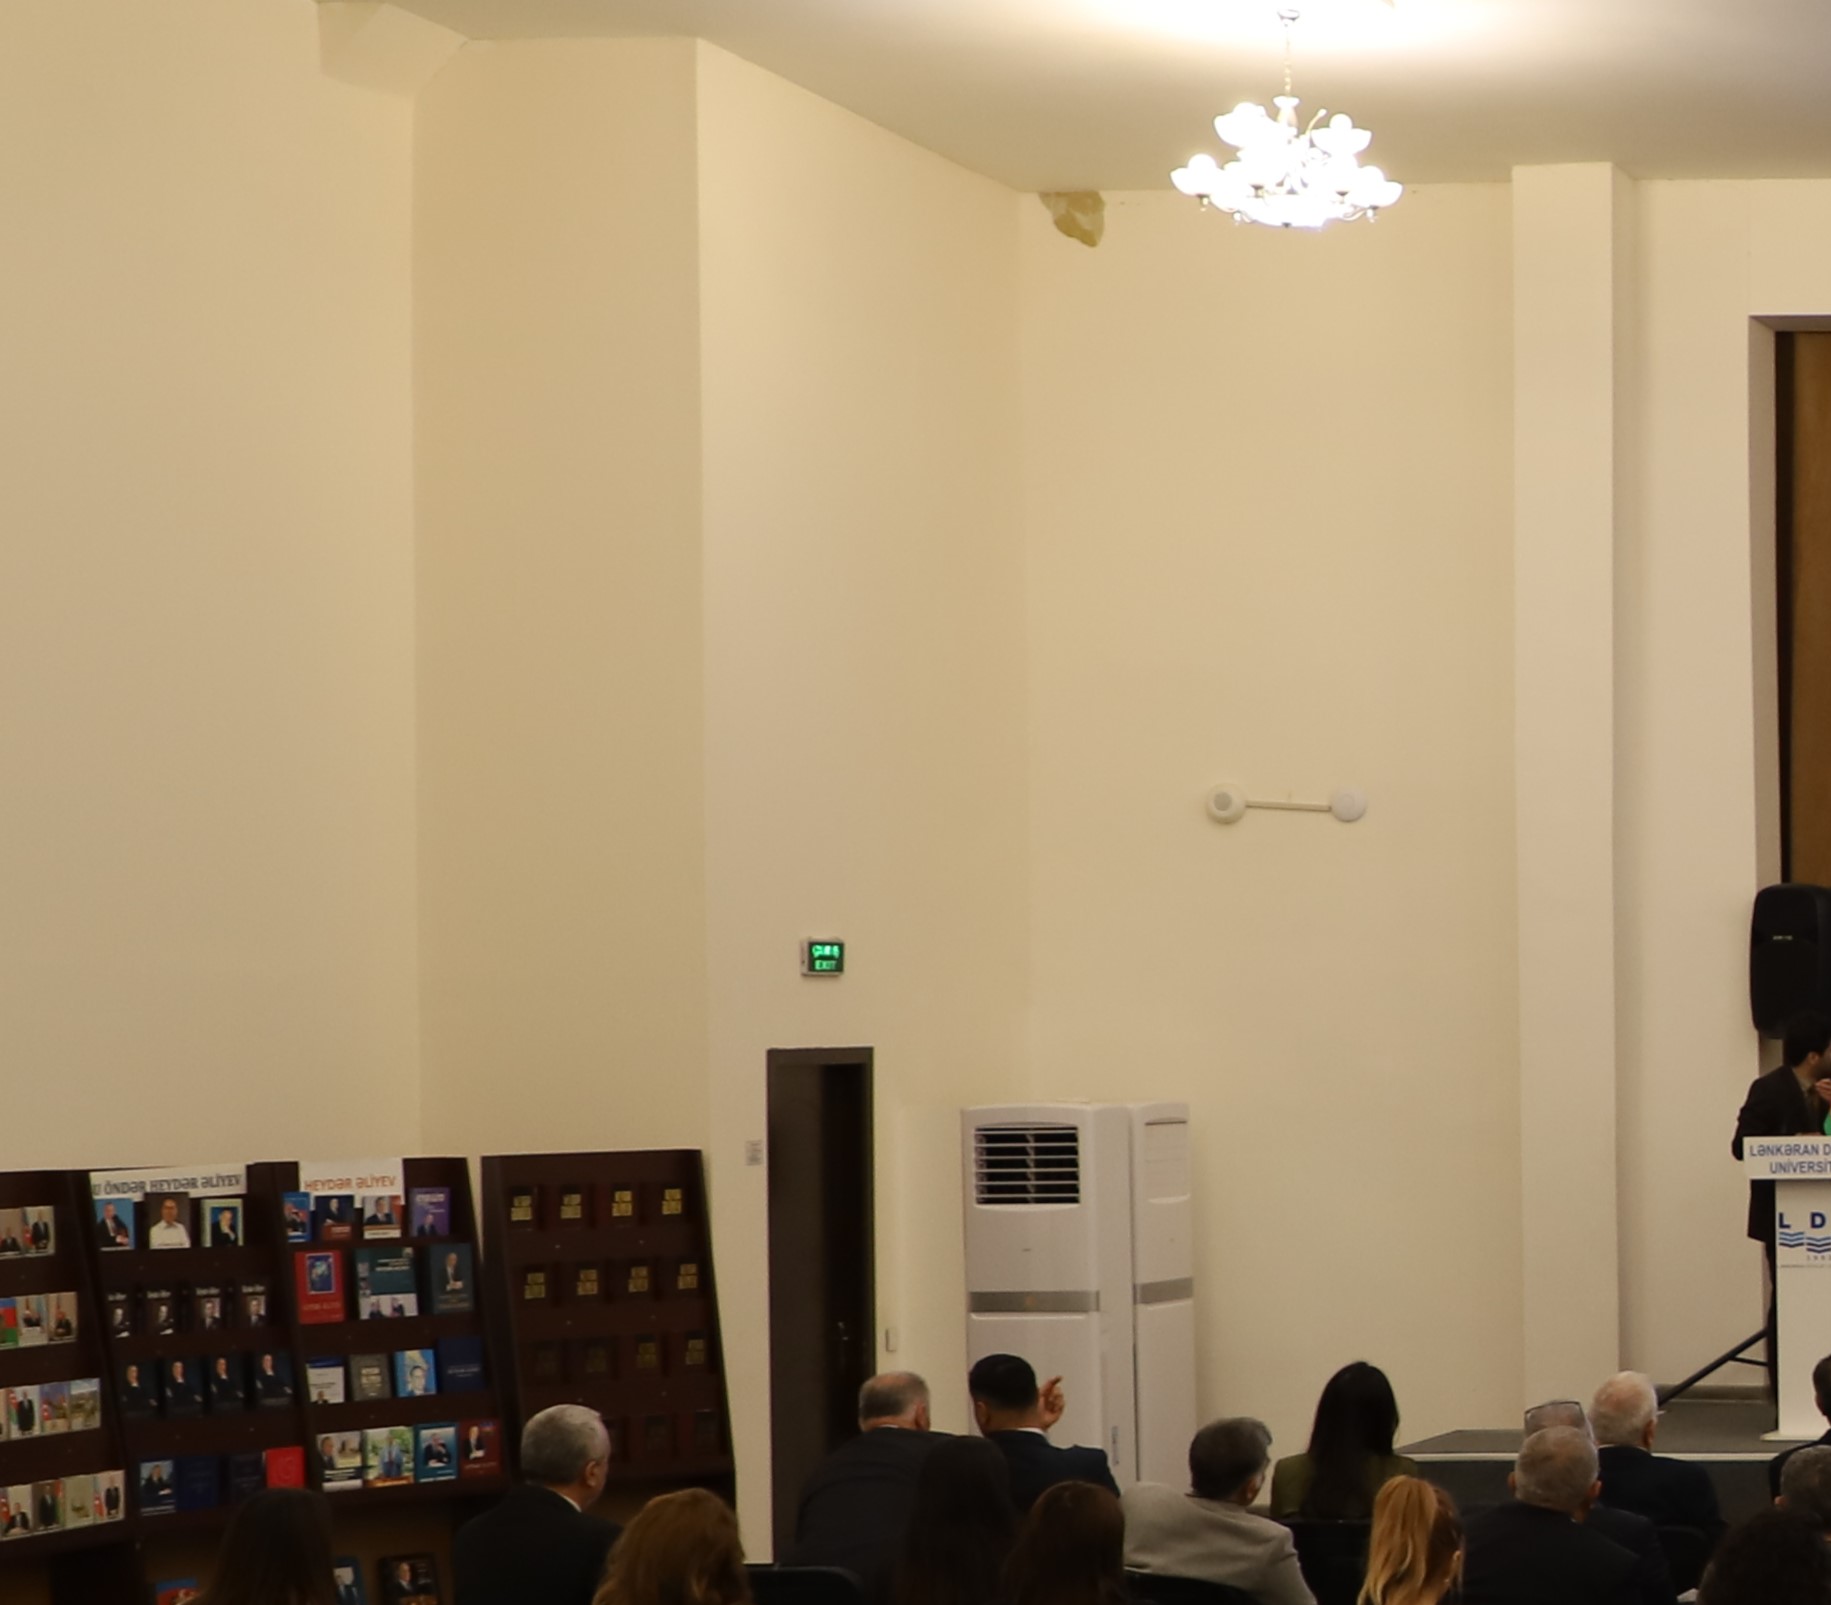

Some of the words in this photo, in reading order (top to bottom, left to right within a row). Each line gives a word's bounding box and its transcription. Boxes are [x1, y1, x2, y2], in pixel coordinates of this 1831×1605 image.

[1750, 1144, 1820, 1156] LƏNKƏRAN
[104, 1179, 146, 1195] ÖNDƏR
[150, 1177, 199, 1193] HEYDƏR
[201, 1173, 242, 1188] ƏLİYEV
[304, 1178, 352, 1191] HEYDƏR
[355, 1174, 396, 1189] ƏLİYEV
